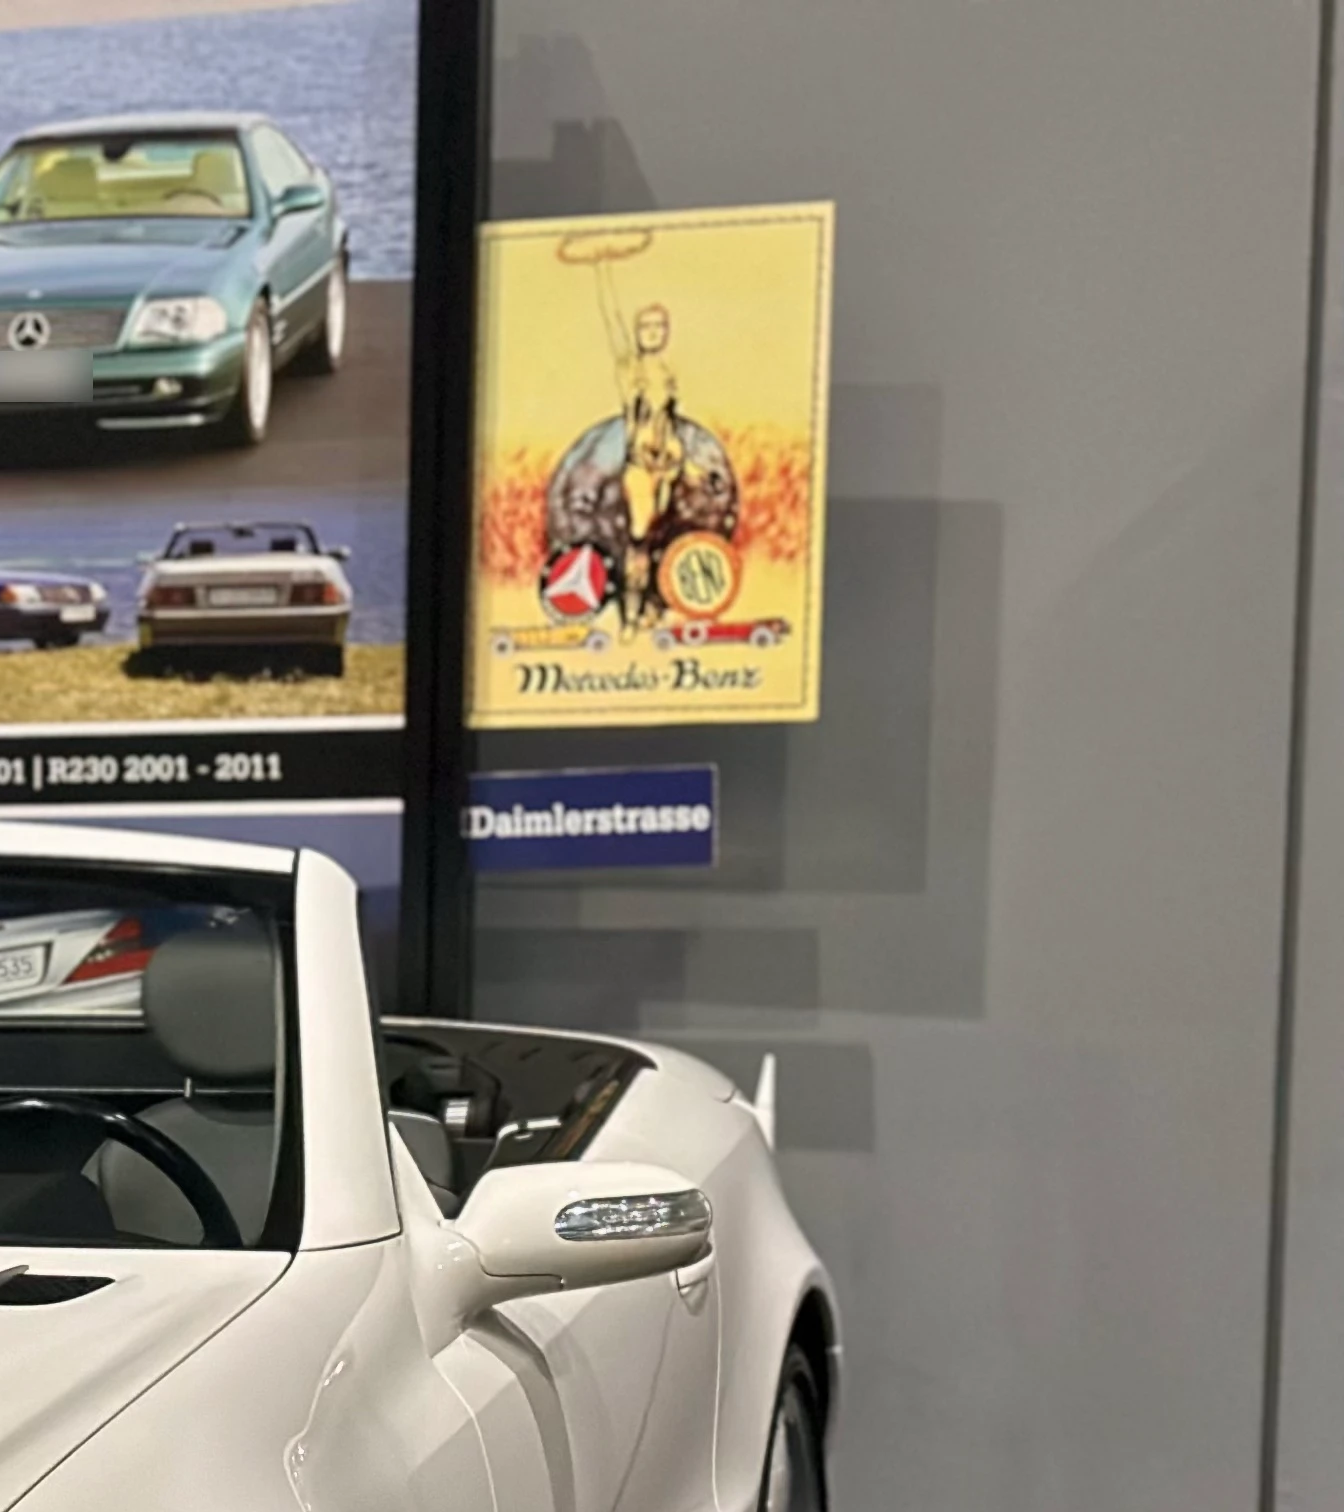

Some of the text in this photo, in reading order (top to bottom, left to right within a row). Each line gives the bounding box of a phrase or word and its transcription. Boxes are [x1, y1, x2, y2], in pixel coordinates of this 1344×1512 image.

[516, 658, 762, 694] Mercedes-Benz
[46, 757, 118, 784] R230
[123, 756, 189, 783] 2001
[214, 753, 282, 781] 2011
[467, 801, 711, 840] Daimlerstrasse
